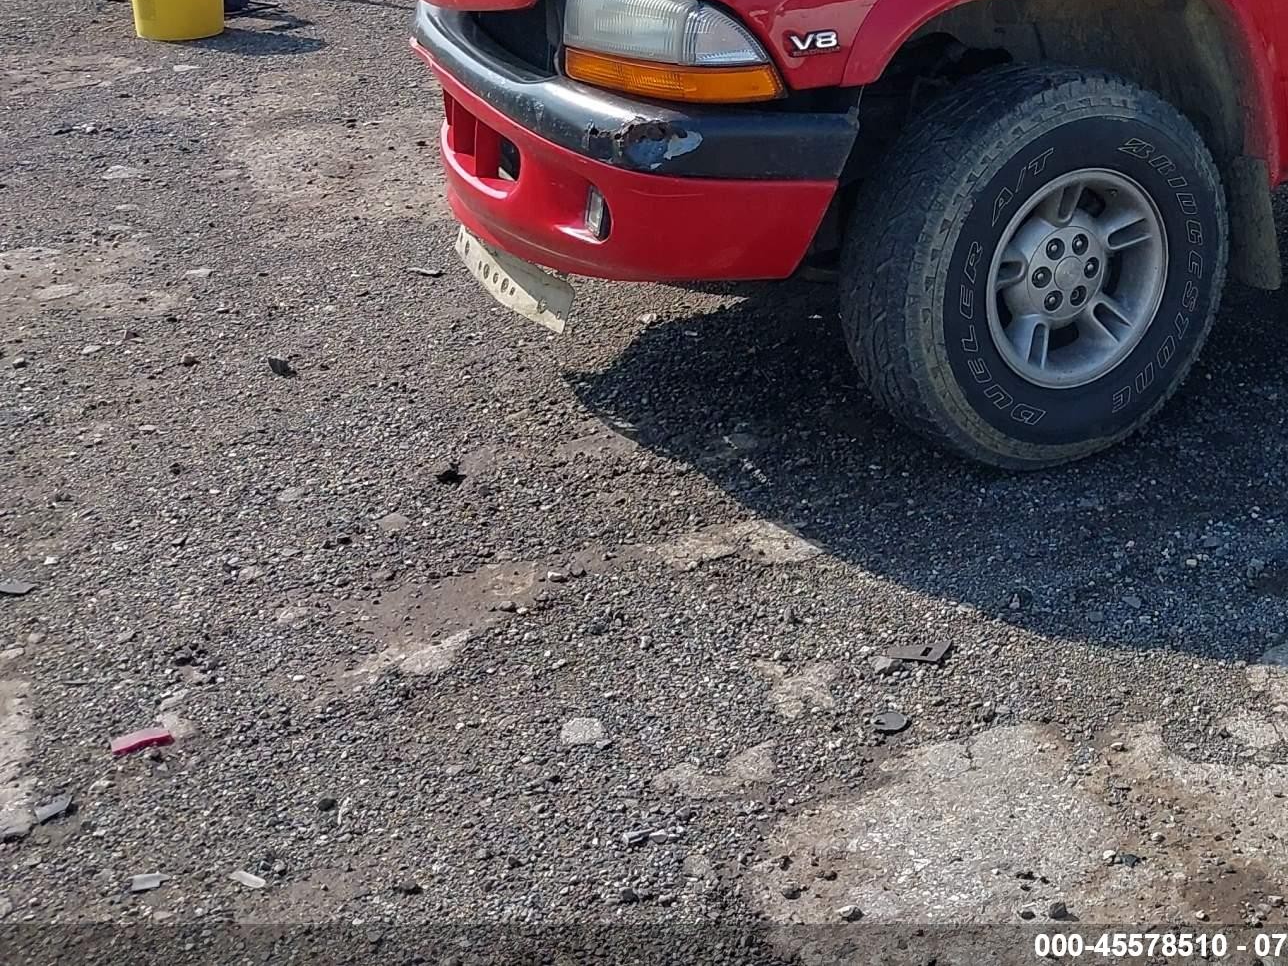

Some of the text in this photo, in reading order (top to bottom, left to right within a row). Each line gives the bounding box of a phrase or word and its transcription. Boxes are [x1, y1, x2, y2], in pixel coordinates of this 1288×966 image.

[789, 30, 838, 51] V8
[958, 146, 1055, 426] DUELER A/T
[1111, 136, 1205, 414] BRIDGESTONE
